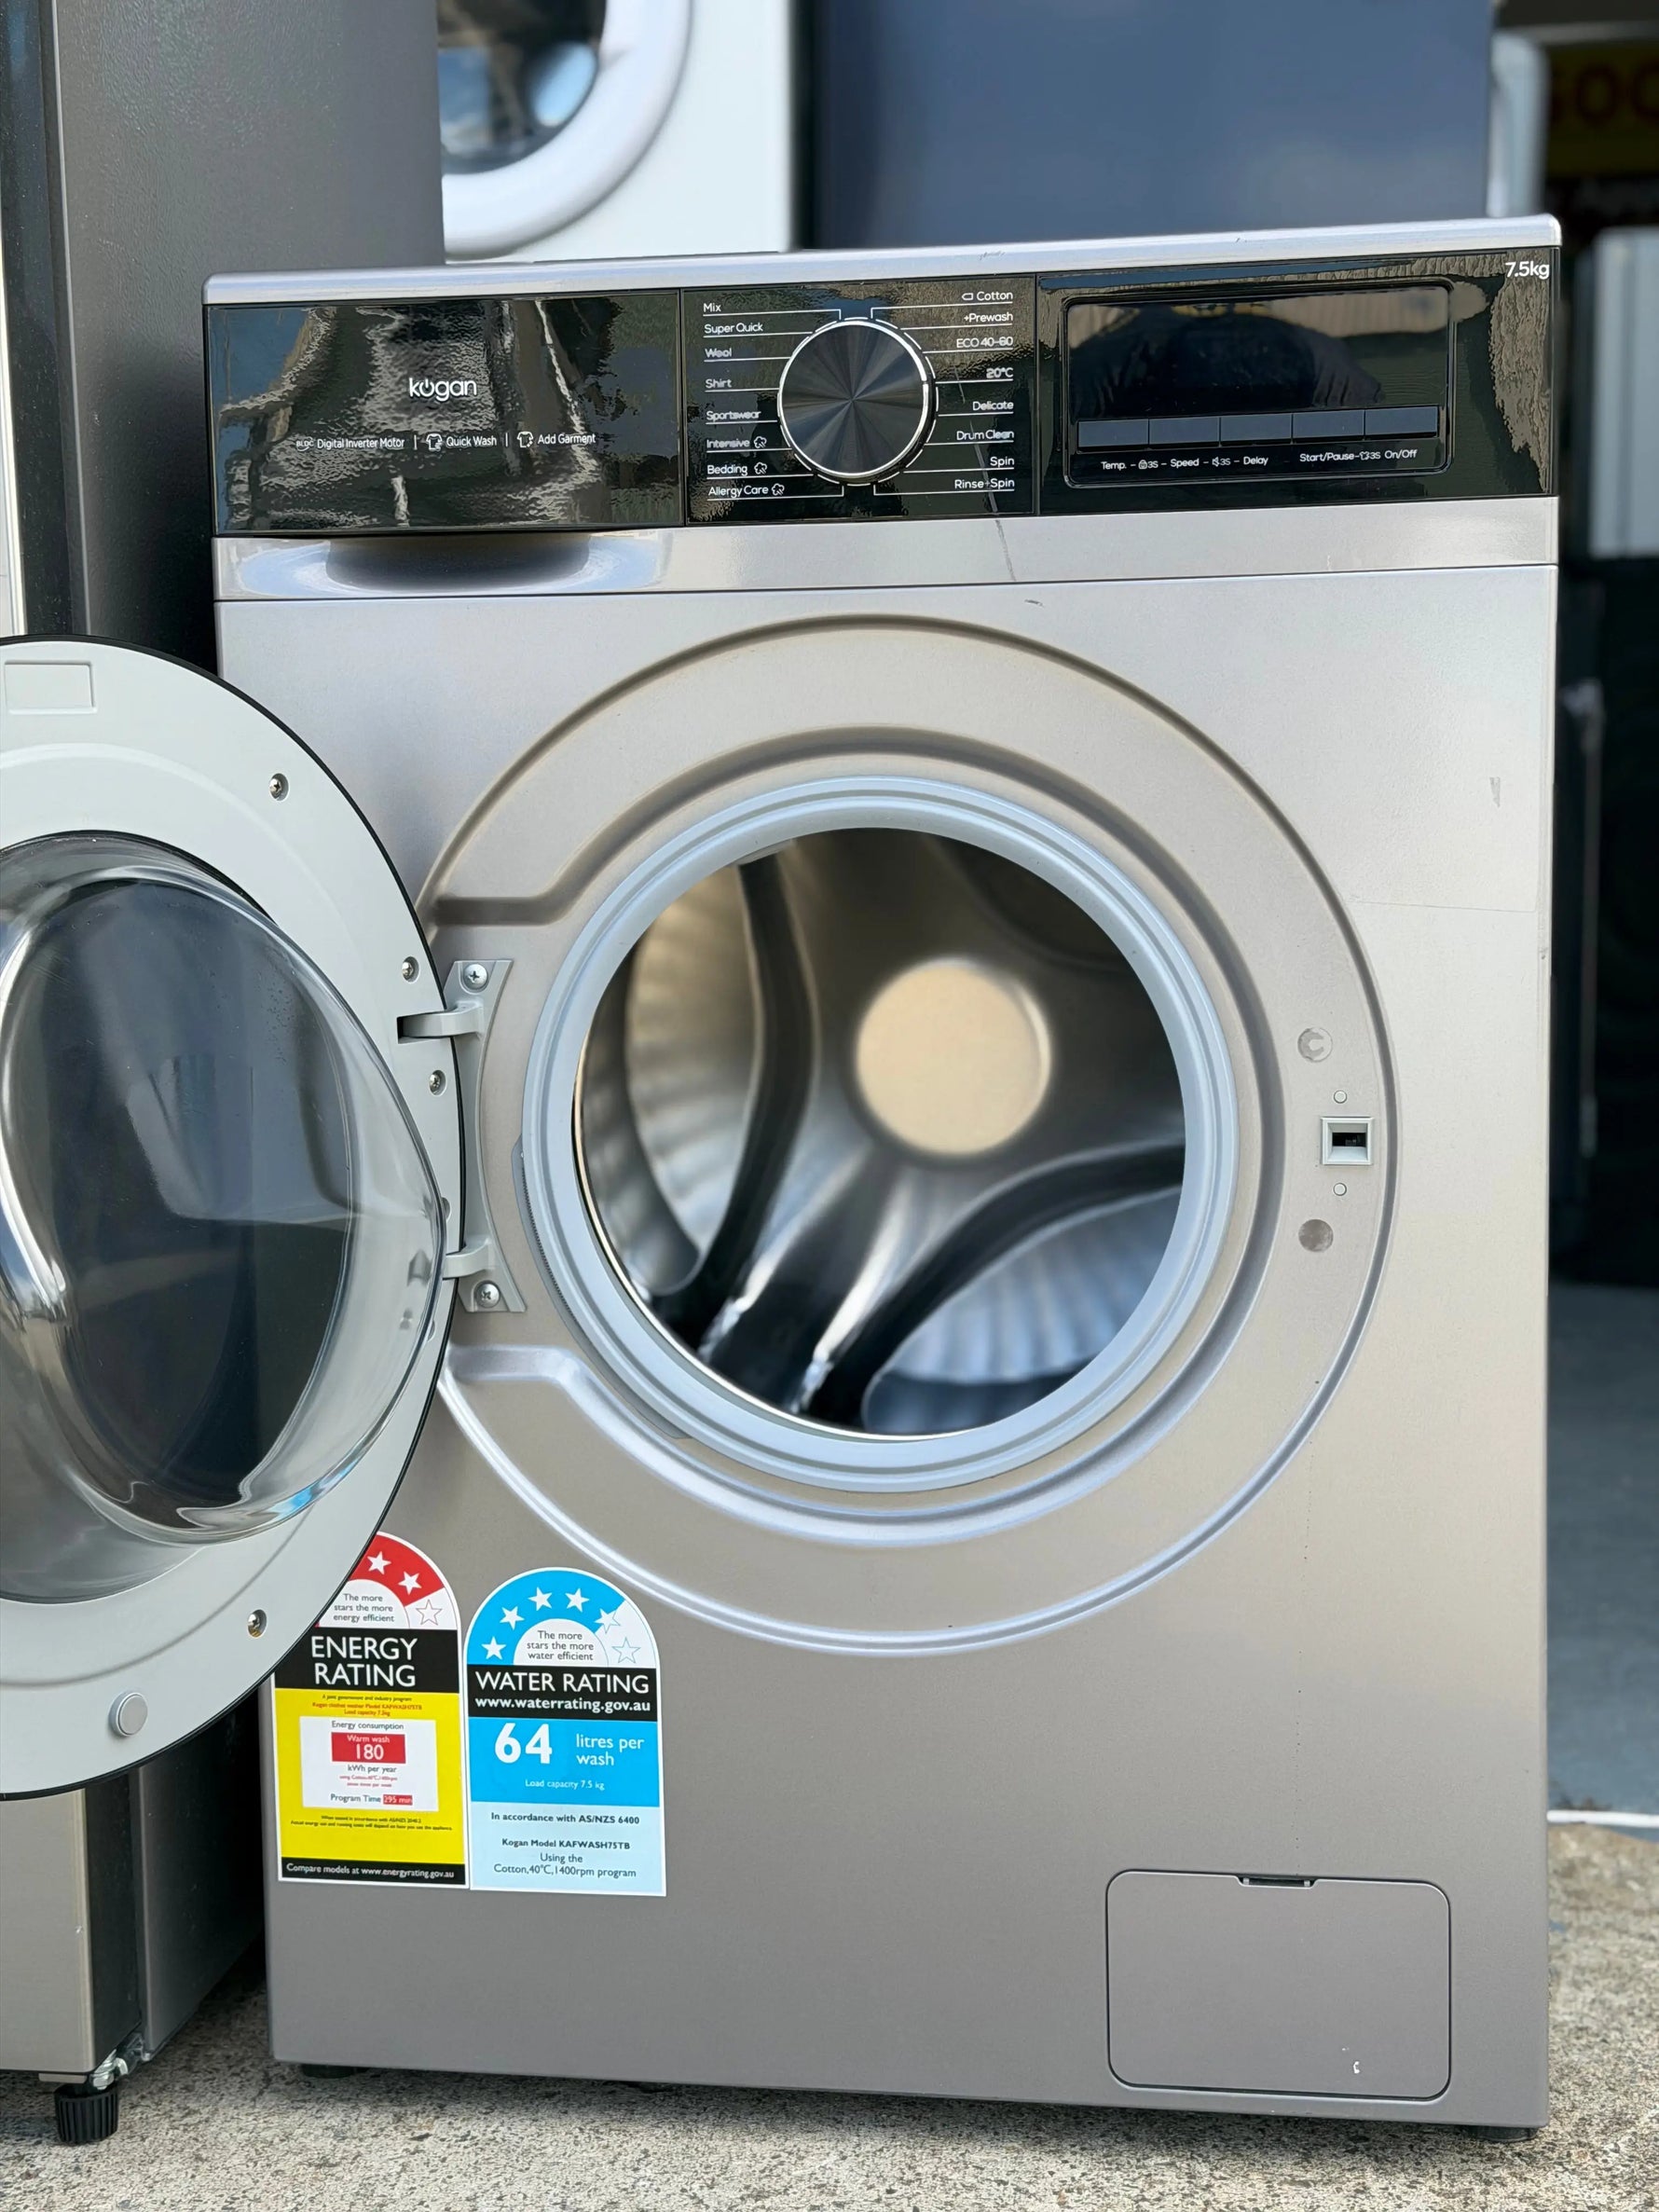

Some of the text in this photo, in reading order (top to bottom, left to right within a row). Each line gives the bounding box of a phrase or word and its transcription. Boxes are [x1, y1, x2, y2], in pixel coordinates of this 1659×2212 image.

[1505, 260, 1550, 280] 7.5kg
[977, 291, 1013, 301] Cotton
[703, 303, 721, 312] Mix
[704, 322, 763, 335] Super Quick
[956, 337, 980, 349] ECO
[705, 348, 732, 358] Wool
[986, 367, 1013, 379] 20°C
[409, 377, 477, 402] kogan
[706, 378, 732, 389] Shirt
[972, 401, 1014, 411] Delicate
[706, 410, 761, 422] Sportswear
[538, 433, 596, 445] Add Garment
[956, 429, 1014, 440] Drum Clean
[317, 438, 345, 450] Digital
[346, 437, 377, 448] Inverter
[379, 437, 404, 447] Motor
[446, 435, 497, 447] Quick Wash
[706, 438, 750, 448] Intensive
[1384, 449, 1418, 460] On/Off
[990, 456, 1014, 468] Spin
[1101, 460, 1127, 471] Temp.
[1170, 458, 1200, 469] Speed
[1242, 456, 1268, 466] Delay
[706, 464, 747, 476] Bedding
[707, 485, 769, 499] Allergy Care
[343, 1593, 359, 1601] The
[333, 1614, 360, 1624] energy
[538, 1630, 583, 1641] The more
[311, 1636, 418, 1660] ENERGY
[527, 1642, 595, 1651] stars the more
[528, 1651, 594, 1661] water efficient
[314, 1663, 416, 1687] RATING
[475, 1671, 650, 1694] WATER RATING
[475, 1697, 651, 1714] www.waterrating.gov.au
[331, 1720, 404, 1731] Energy consumption
[495, 1723, 553, 1765] 64
[575, 1733, 645, 1752] litres per
[356, 1743, 384, 1761] 180
[576, 1752, 614, 1766] wash
[525, 1779, 605, 1791] Load capacity 7.5 kg
[330, 1793, 381, 1804] Program Time
[384, 1795, 397, 1804] 295
[491, 1812, 640, 1824] In accordance with AS/NZS 6400
[501, 1838, 630, 1849] Kogan Model KAFWASH75TB
[540, 1853, 583, 1864] Using the
[286, 1862, 322, 1874] Compare
[322, 1865, 350, 1874] models
[361, 1868, 455, 1879] www.energyrating.gov.au
[494, 1862, 637, 1879] Cotton,40°C,1400rpm program
